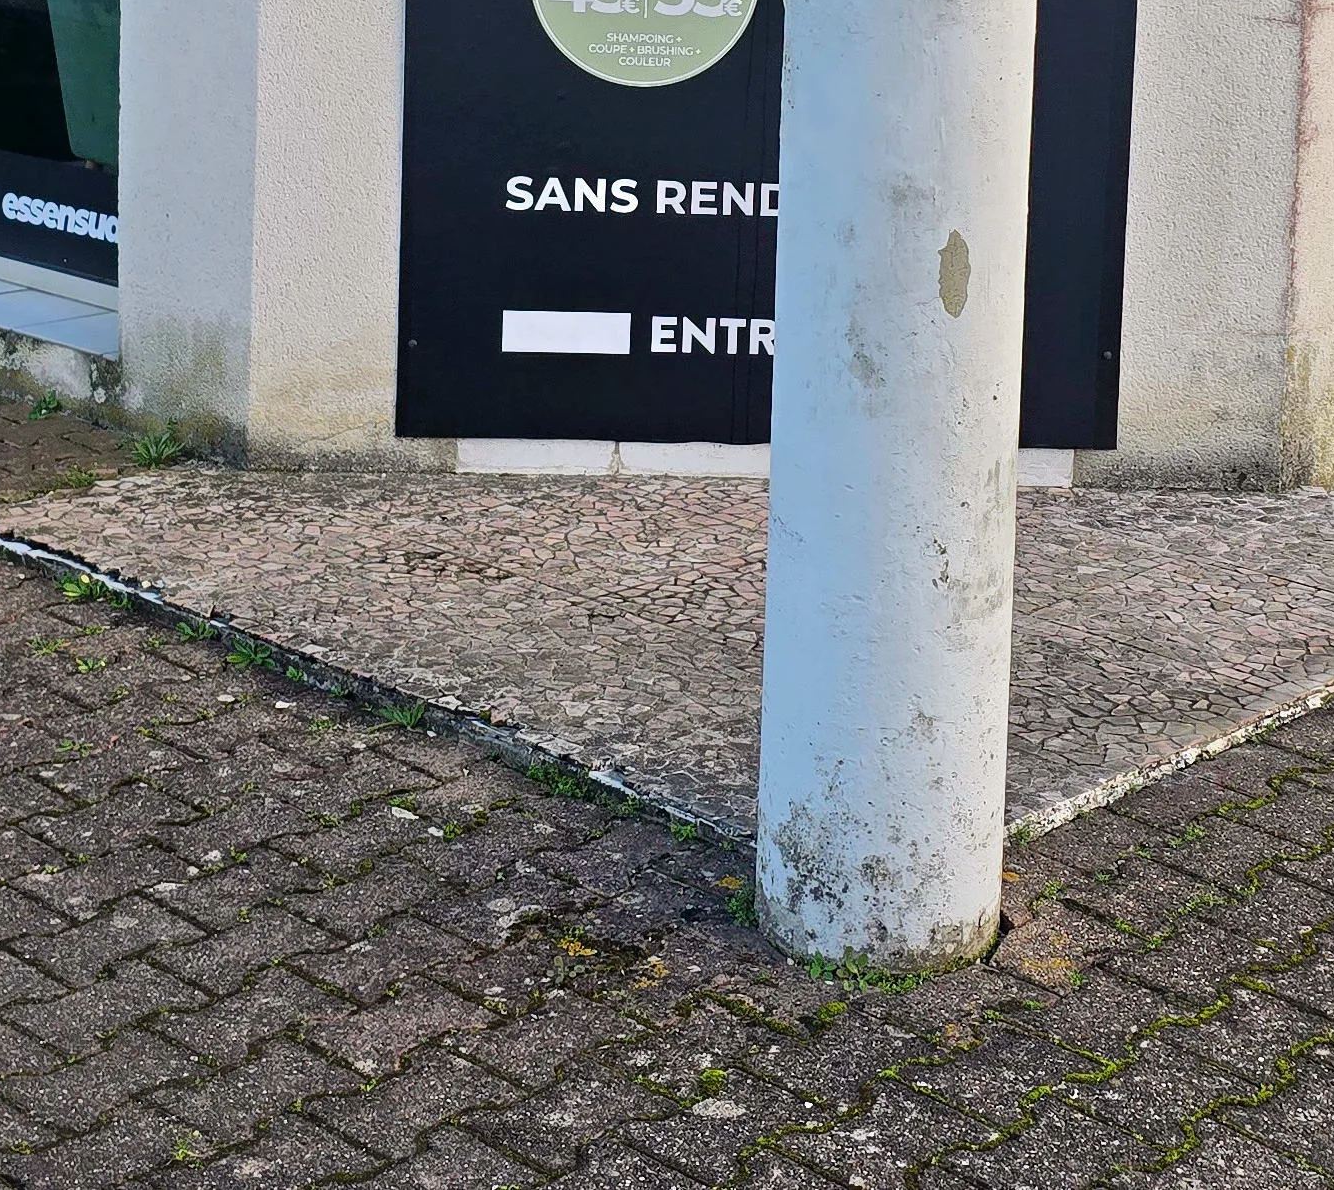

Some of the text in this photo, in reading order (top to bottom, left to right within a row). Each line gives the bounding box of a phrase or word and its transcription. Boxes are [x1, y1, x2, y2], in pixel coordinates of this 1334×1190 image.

[606, 32, 674, 44] SHAMPOING
[588, 43, 627, 54] COUPE
[637, 45, 694, 56] BRUSHING
[618, 56, 671, 67] COULEUR
[505, 175, 639, 214] SANS
[650, 316, 776, 355] ENTR
